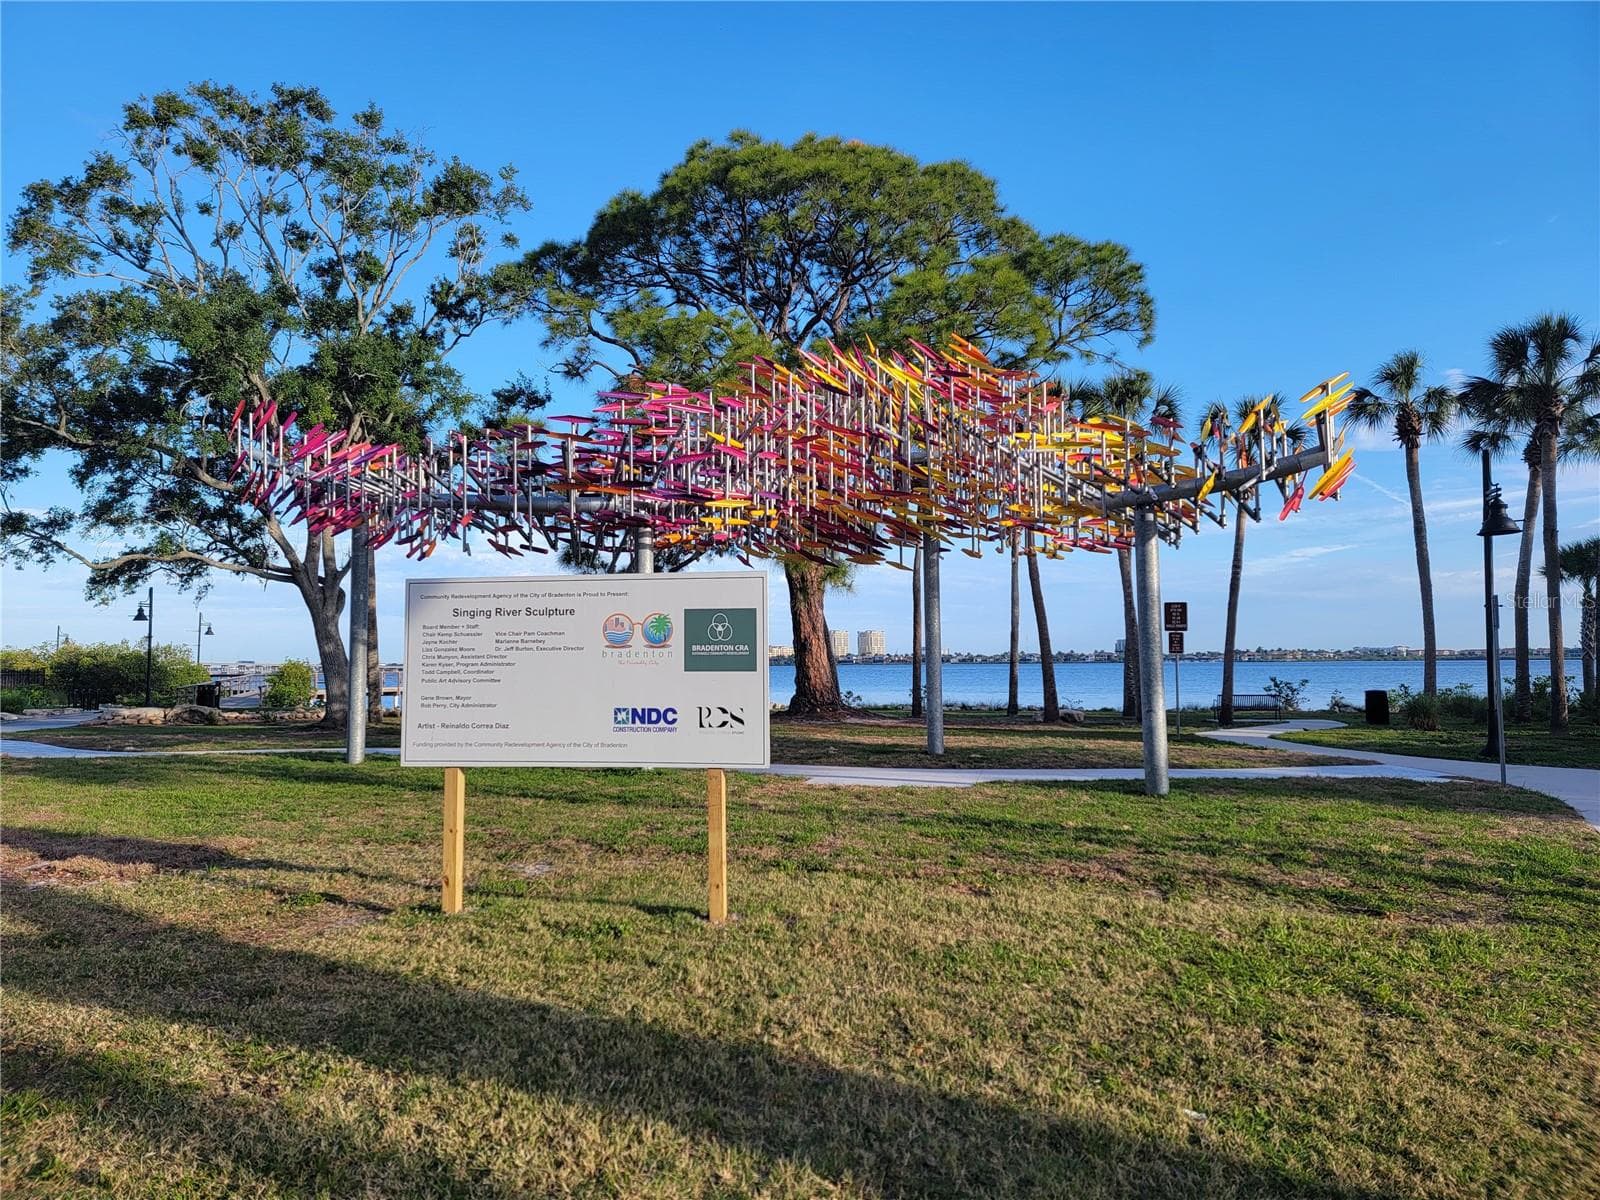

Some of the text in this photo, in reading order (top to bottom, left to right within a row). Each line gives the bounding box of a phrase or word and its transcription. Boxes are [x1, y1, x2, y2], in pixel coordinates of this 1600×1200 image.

[452, 607, 575, 619] Singing River Sculpture
[631, 708, 677, 725] NDC
